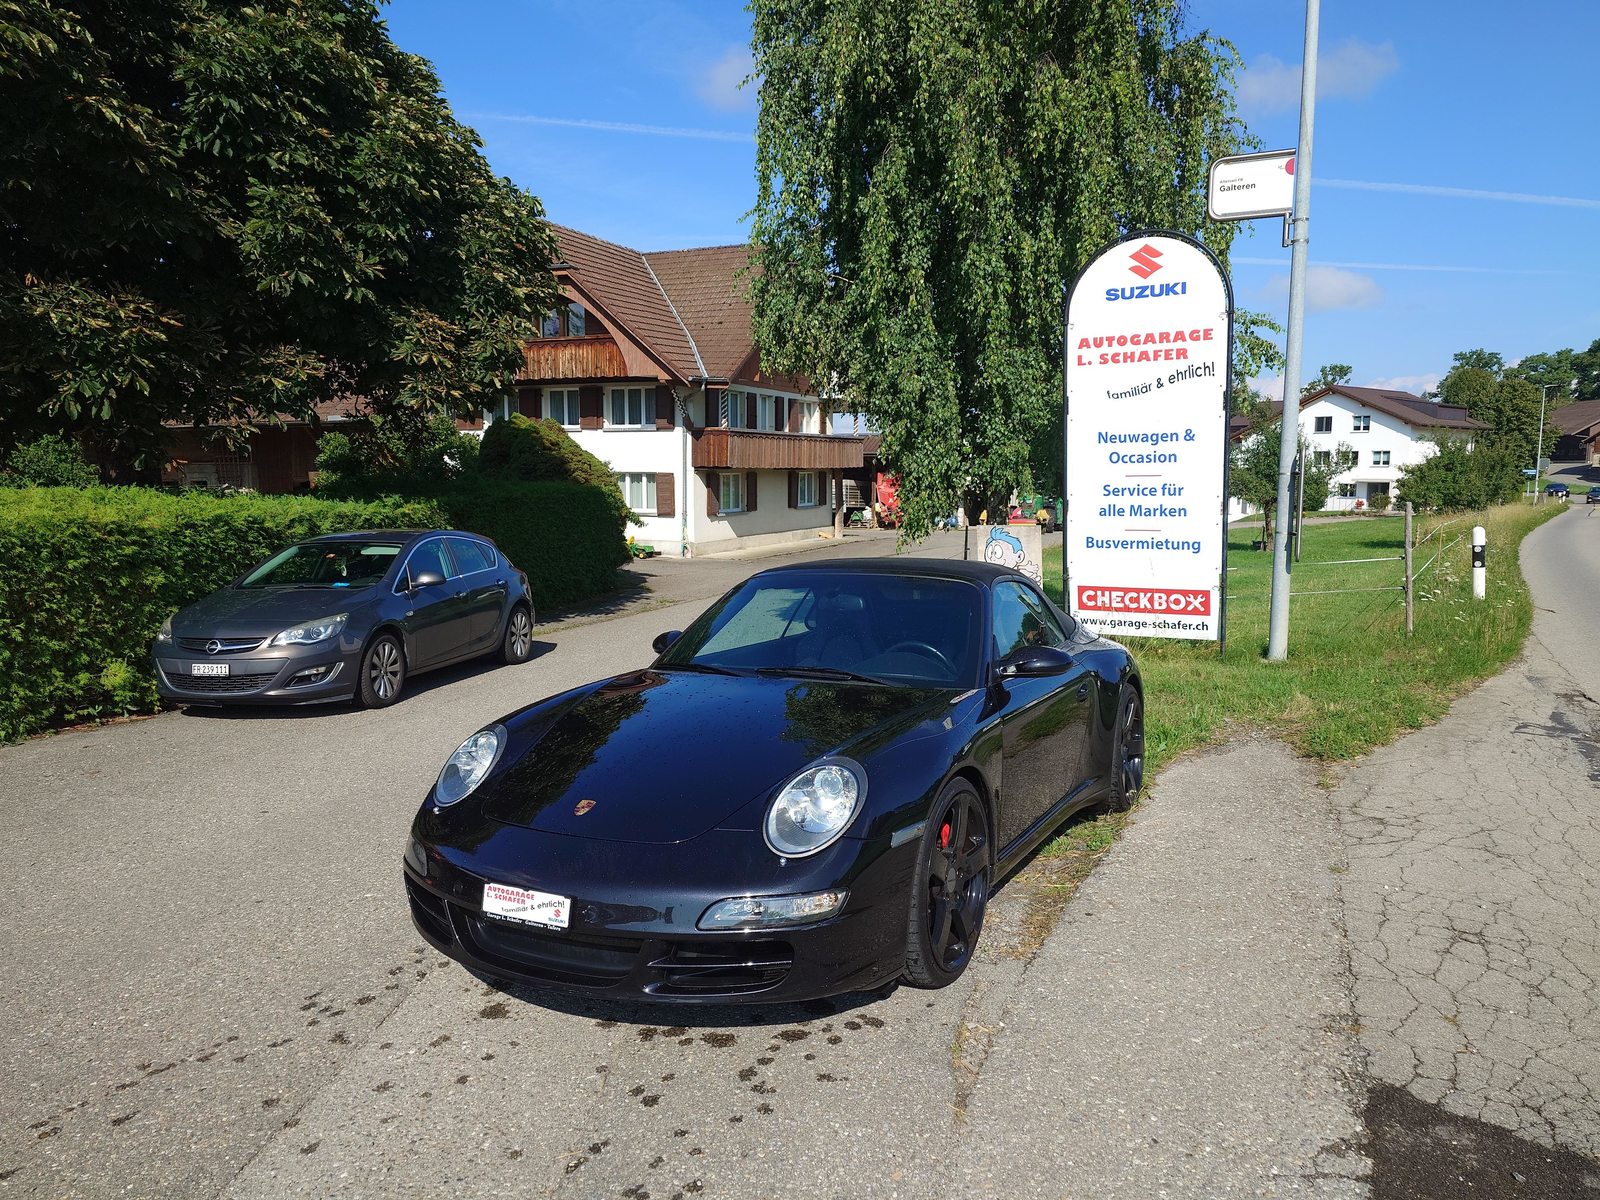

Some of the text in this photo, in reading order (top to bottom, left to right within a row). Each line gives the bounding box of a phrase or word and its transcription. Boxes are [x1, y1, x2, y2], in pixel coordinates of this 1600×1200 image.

[1219, 183, 1256, 192] Galteren
[1105, 281, 1187, 301] SUZUKI
[1077, 328, 1214, 349] AUTOGARAGE
[1077, 347, 1188, 366] L. SCHAFER
[1106, 361, 1216, 400] familiär & ehrlich!
[1097, 428, 1196, 446] Neuwagen &
[1108, 450, 1178, 464] Occasion
[1103, 483, 1184, 497] Service für
[1099, 504, 1188, 517] alle Marken
[1085, 536, 1201, 554] Busvermietung
[1081, 589, 1206, 612] CHECKBOX
[1080, 616, 1209, 631] www.garage-schafer.ch
[487, 885, 535, 900] AUTOGARAGE
[494, 893, 526, 905] SCHAFER
[537, 900, 565, 909] ehrlich!
